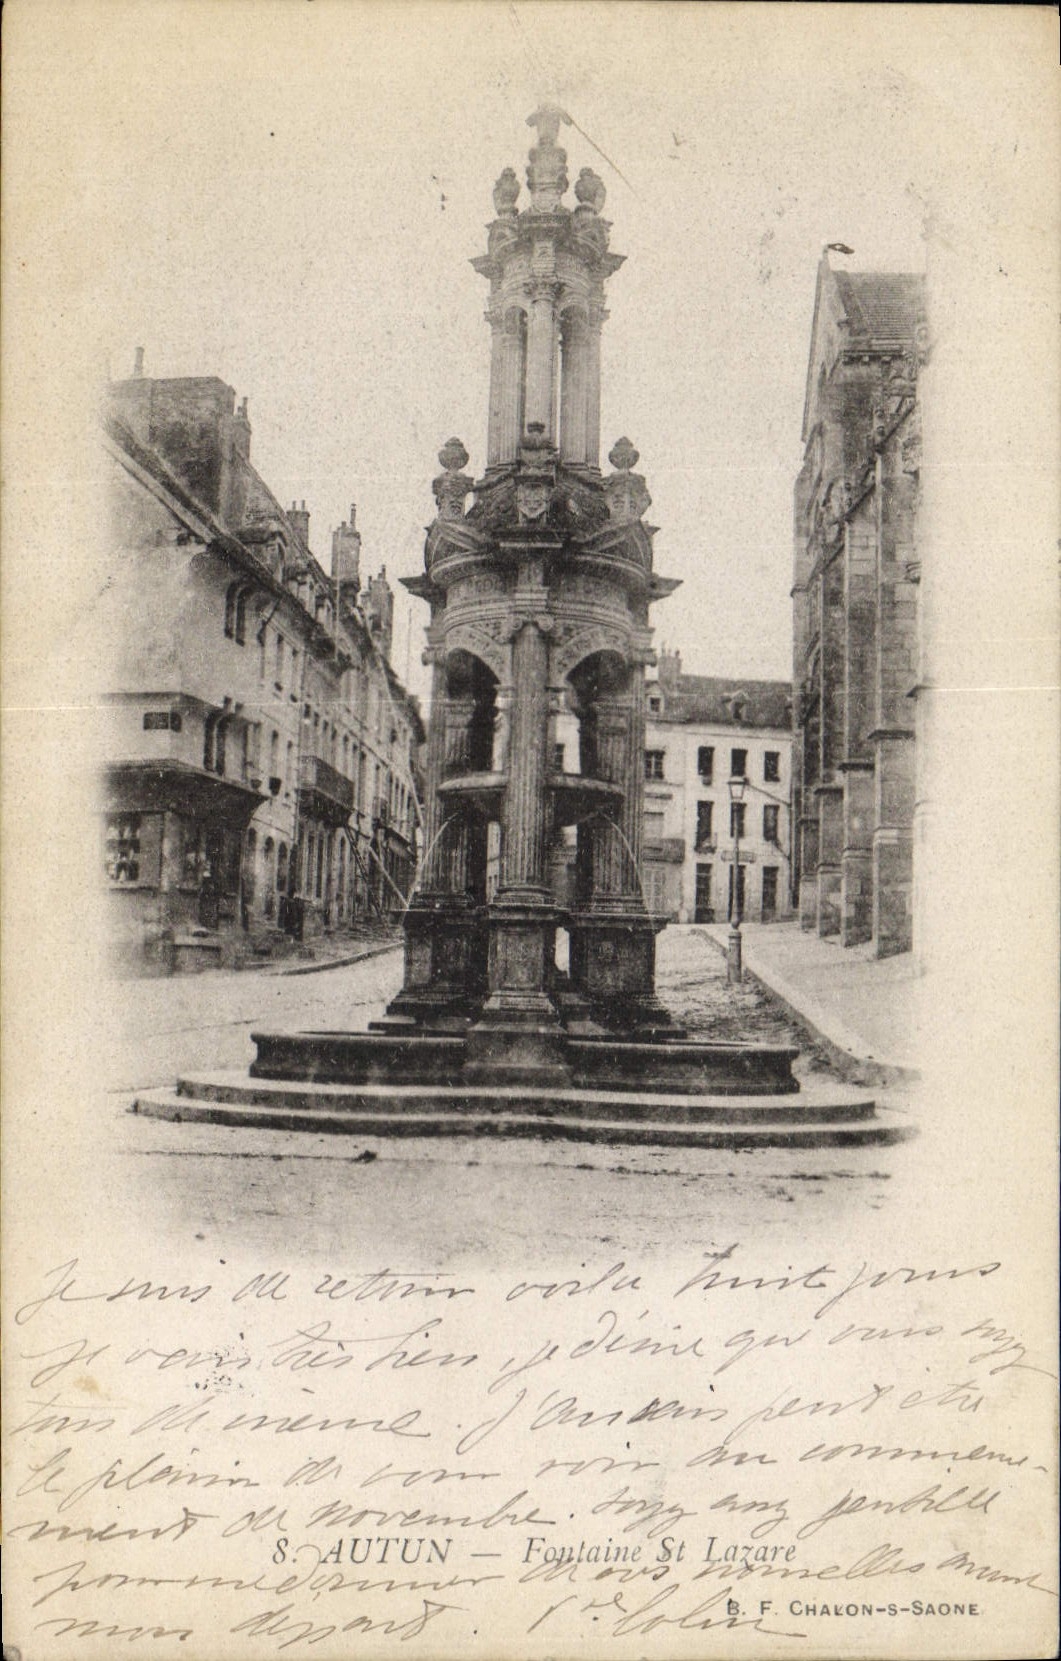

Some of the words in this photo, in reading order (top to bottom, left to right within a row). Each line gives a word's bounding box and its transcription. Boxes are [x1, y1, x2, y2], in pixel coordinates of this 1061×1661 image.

[15, 1258, 78, 1325] Je
[231, 1271, 290, 1300] de
[314, 1268, 475, 1301] retour
[673, 1243, 836, 1298] huit
[814, 1263, 1002, 1319] jours
[828, 1324, 944, 1345] vous
[130, 1396, 214, 1436] de
[58, 1447, 260, 1513] plaisir
[283, 1455, 342, 1487] de
[686, 1445, 778, 1468] au
[221, 1505, 288, 1538] de
